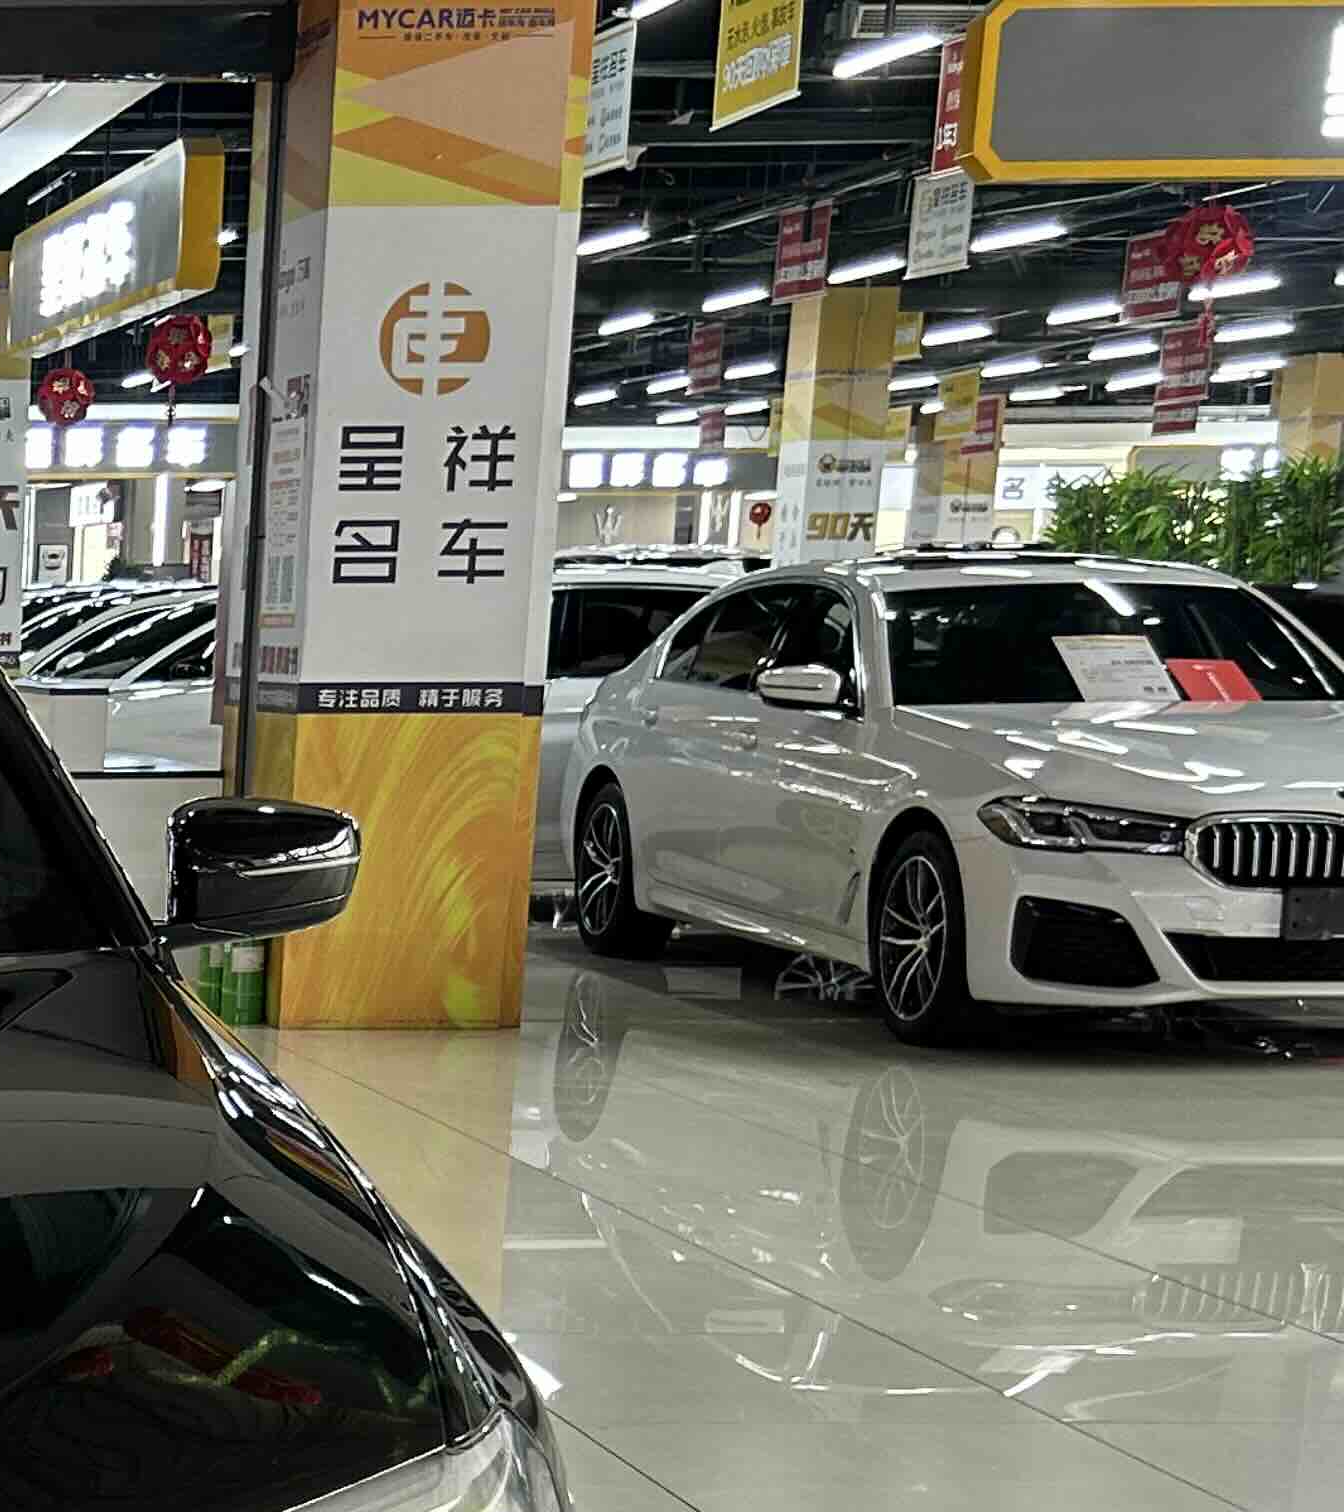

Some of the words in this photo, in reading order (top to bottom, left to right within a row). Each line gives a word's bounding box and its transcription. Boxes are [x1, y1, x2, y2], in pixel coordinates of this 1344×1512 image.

[358, 8, 452, 29] MYCAR
[455, 8, 497, 29] 迈卡
[338, 424, 517, 492] 呈祥
[805, 512, 874, 543] 90天
[331, 518, 508, 585] 名车
[317, 689, 402, 709] 专注品质
[418, 687, 505, 709] 精于服务
